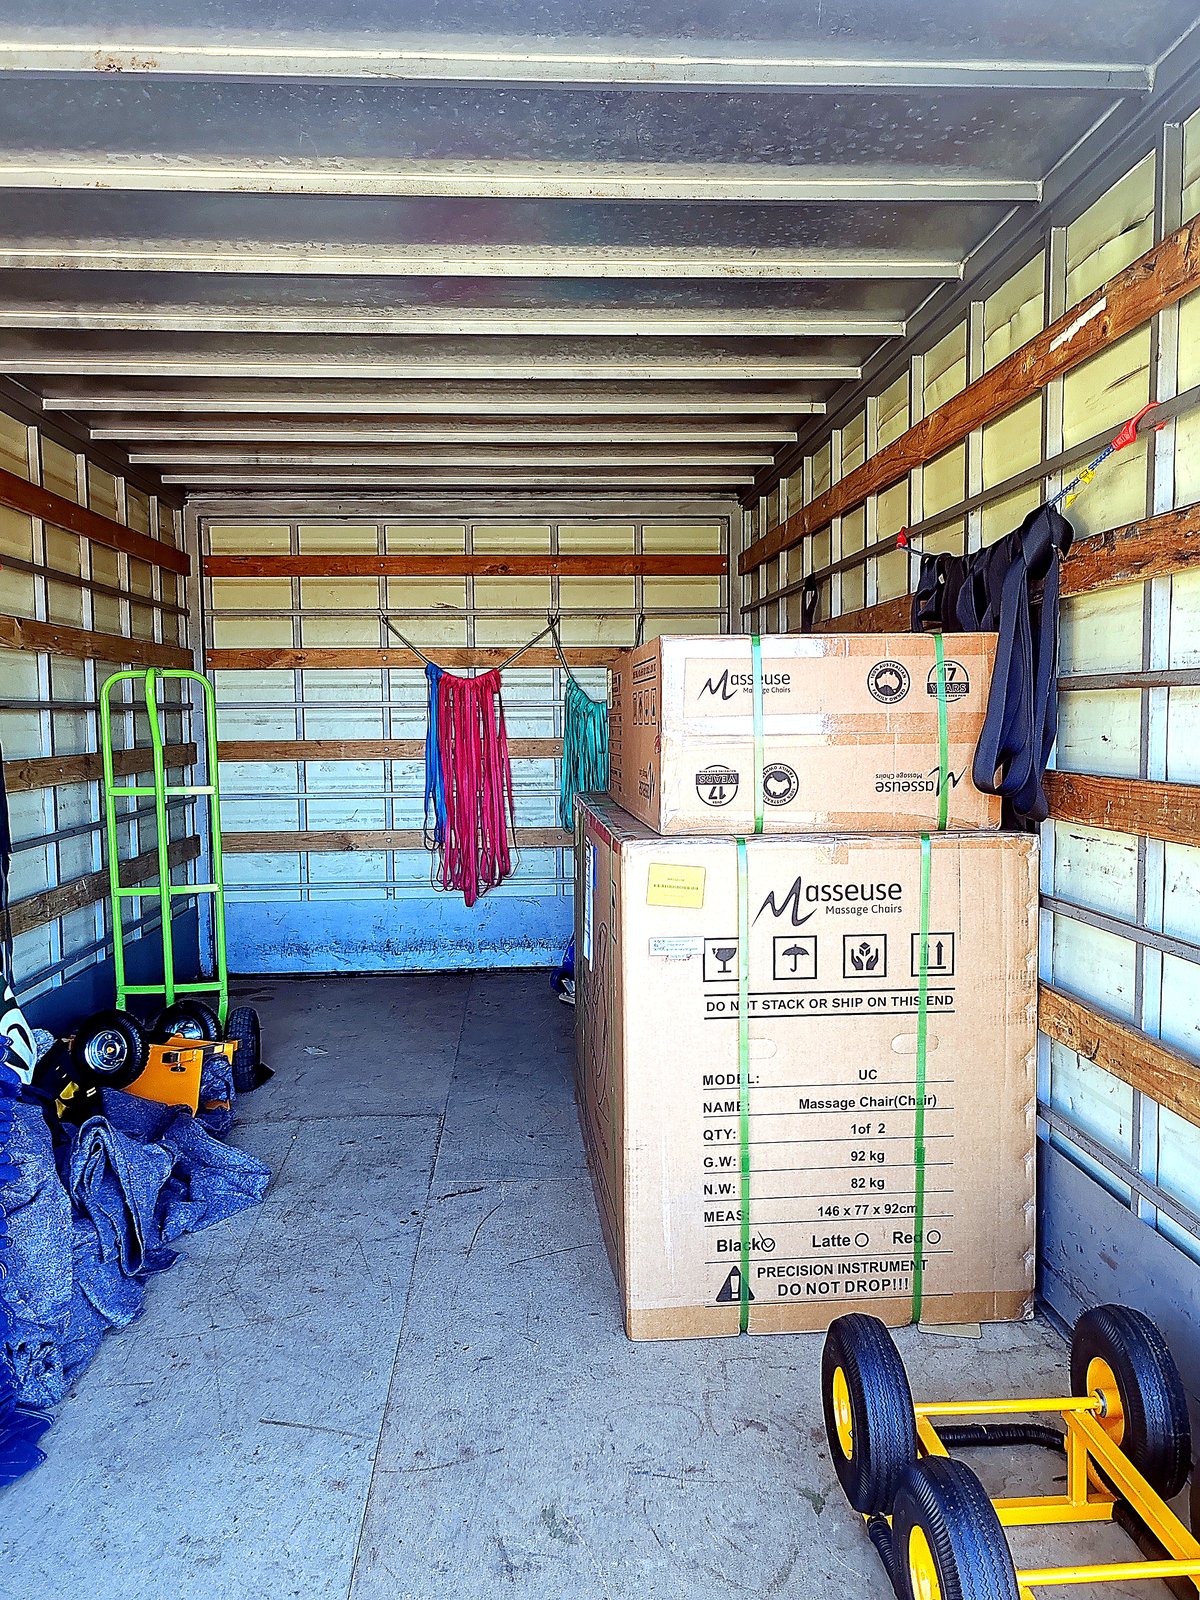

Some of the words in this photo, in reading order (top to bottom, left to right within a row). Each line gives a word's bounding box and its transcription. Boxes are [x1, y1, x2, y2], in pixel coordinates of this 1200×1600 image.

[880, 663, 906, 679] AUSTRALIAN
[697, 669, 790, 700] Massuse
[699, 775, 736, 783] YEARS
[875, 766, 967, 797] Masseuse
[708, 786, 726, 799] 17
[752, 876, 902, 927] Masseuse
[826, 905, 868, 916] Massage
[871, 904, 902, 913] Chairs
[706, 1002, 725, 1011] DO
[731, 1000, 758, 1011] NT
[762, 999, 805, 1010] STACK
[809, 998, 828, 1008] OR
[832, 997, 863, 1008] SHIP
[867, 997, 886, 1007] ON
[891, 996, 921, 1006] THIS
[926, 995, 953, 1006] END
[703, 1074, 759, 1086] MODEL:
[859, 1069, 877, 1080] UC
[799, 1098, 856, 1110] Massage
[703, 1129, 736, 1140] QTY:
[878, 1123, 886, 1133] 2
[703, 1156, 736, 1168] G.W:
[851, 1151, 865, 1161] 92
[870, 1151, 885, 1163] kg
[704, 1184, 735, 1195] N.W:
[851, 1178, 865, 1188] 82
[870, 1177, 885, 1190] kg
[818, 1206, 839, 1216] 146
[843, 1207, 851, 1216] x
[855, 1205, 869, 1215] 77
[873, 1206, 880, 1214] x
[884, 1203, 918, 1214] 92cm
[812, 1234, 850, 1248] Latte
[892, 1230, 922, 1244] Red
[717, 1238, 761, 1252] Black
[757, 1264, 833, 1278] PRECISION
[838, 1260, 928, 1274] INSTRUMENT
[778, 1283, 801, 1296] DO
[806, 1281, 840, 1295] NOT
[844, 1278, 909, 1293] DROP!!!
